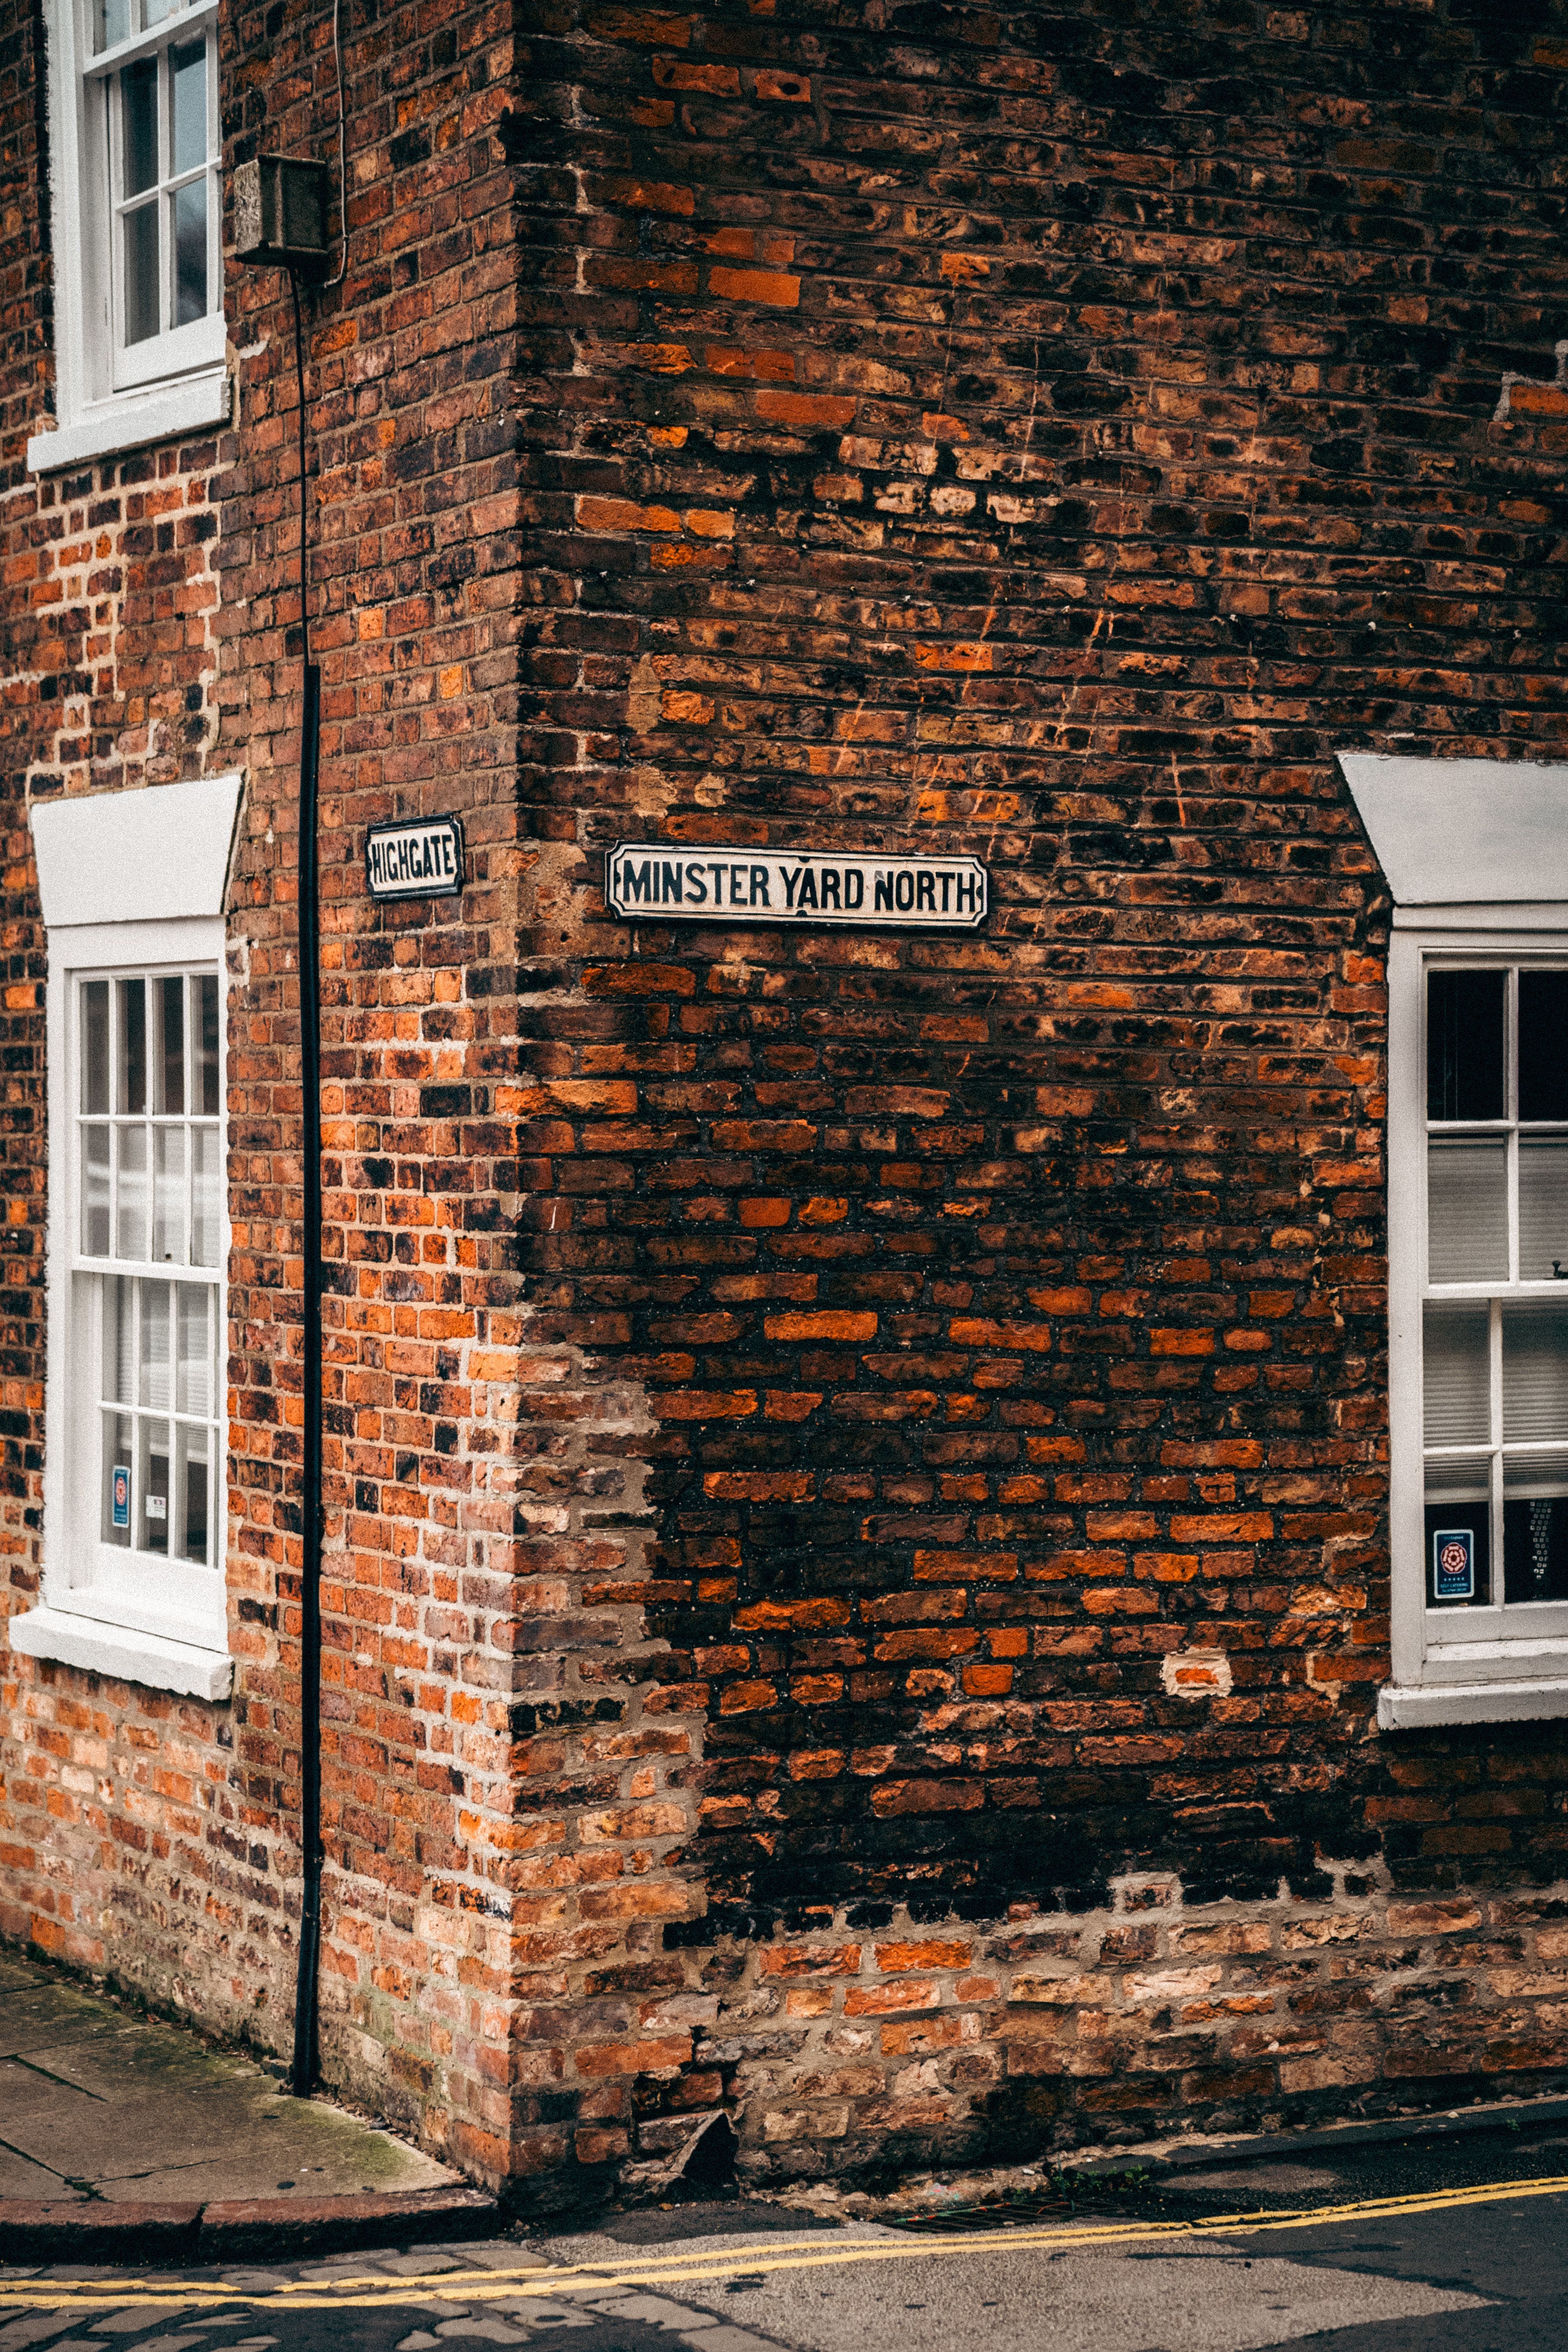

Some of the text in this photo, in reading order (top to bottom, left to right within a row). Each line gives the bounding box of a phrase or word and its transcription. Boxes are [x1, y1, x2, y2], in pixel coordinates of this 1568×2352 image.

[372, 835, 454, 884] HIGHGATE
[623, 860, 975, 912] MINSTER YARD NORTH
